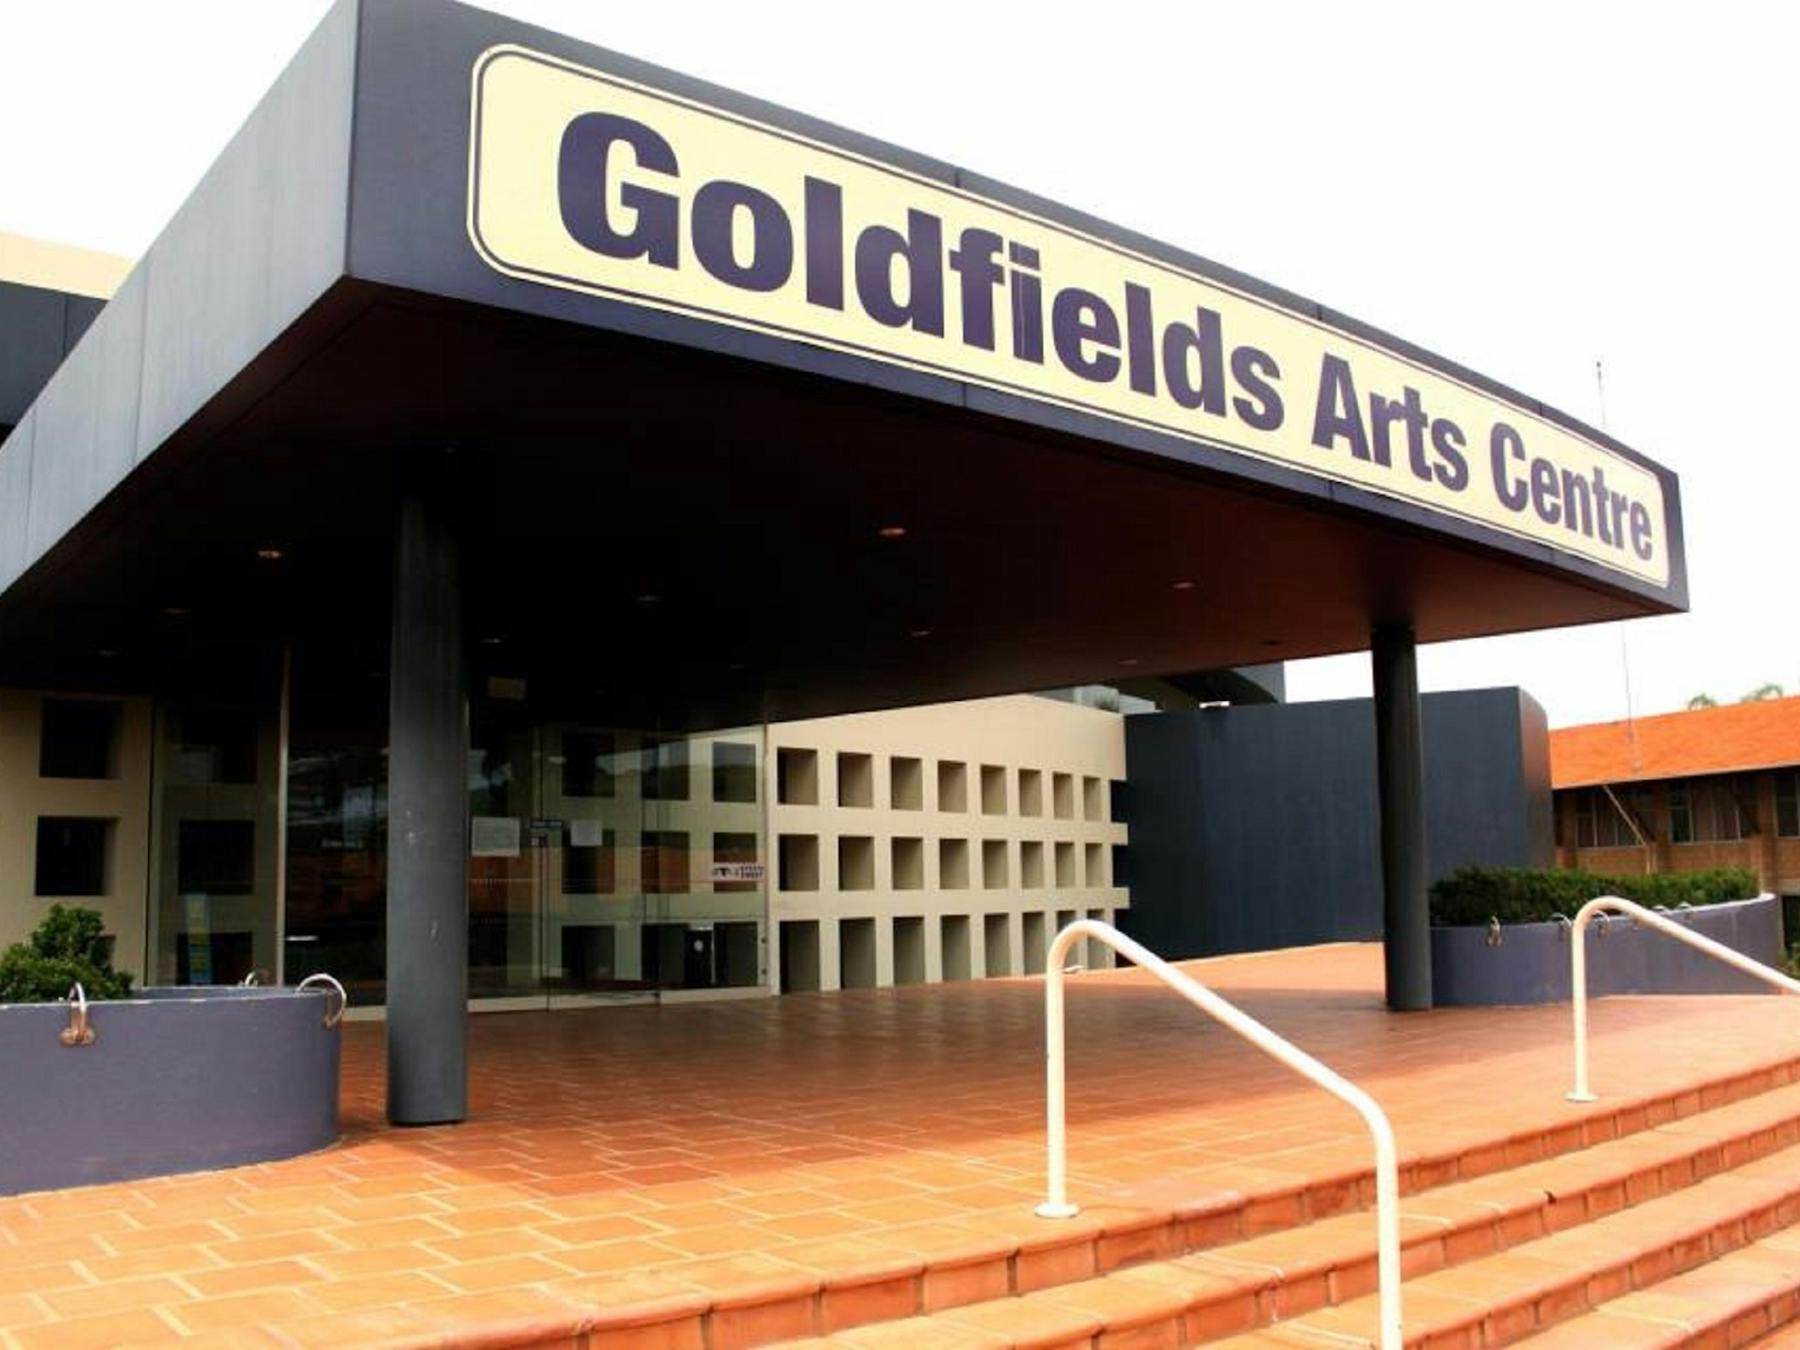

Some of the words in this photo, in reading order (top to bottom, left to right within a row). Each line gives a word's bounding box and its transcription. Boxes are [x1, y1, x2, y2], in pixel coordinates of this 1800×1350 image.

[557, 110, 1284, 431] Goldfields
[1311, 352, 1469, 492] Arts
[1490, 421, 1653, 561] Centre
